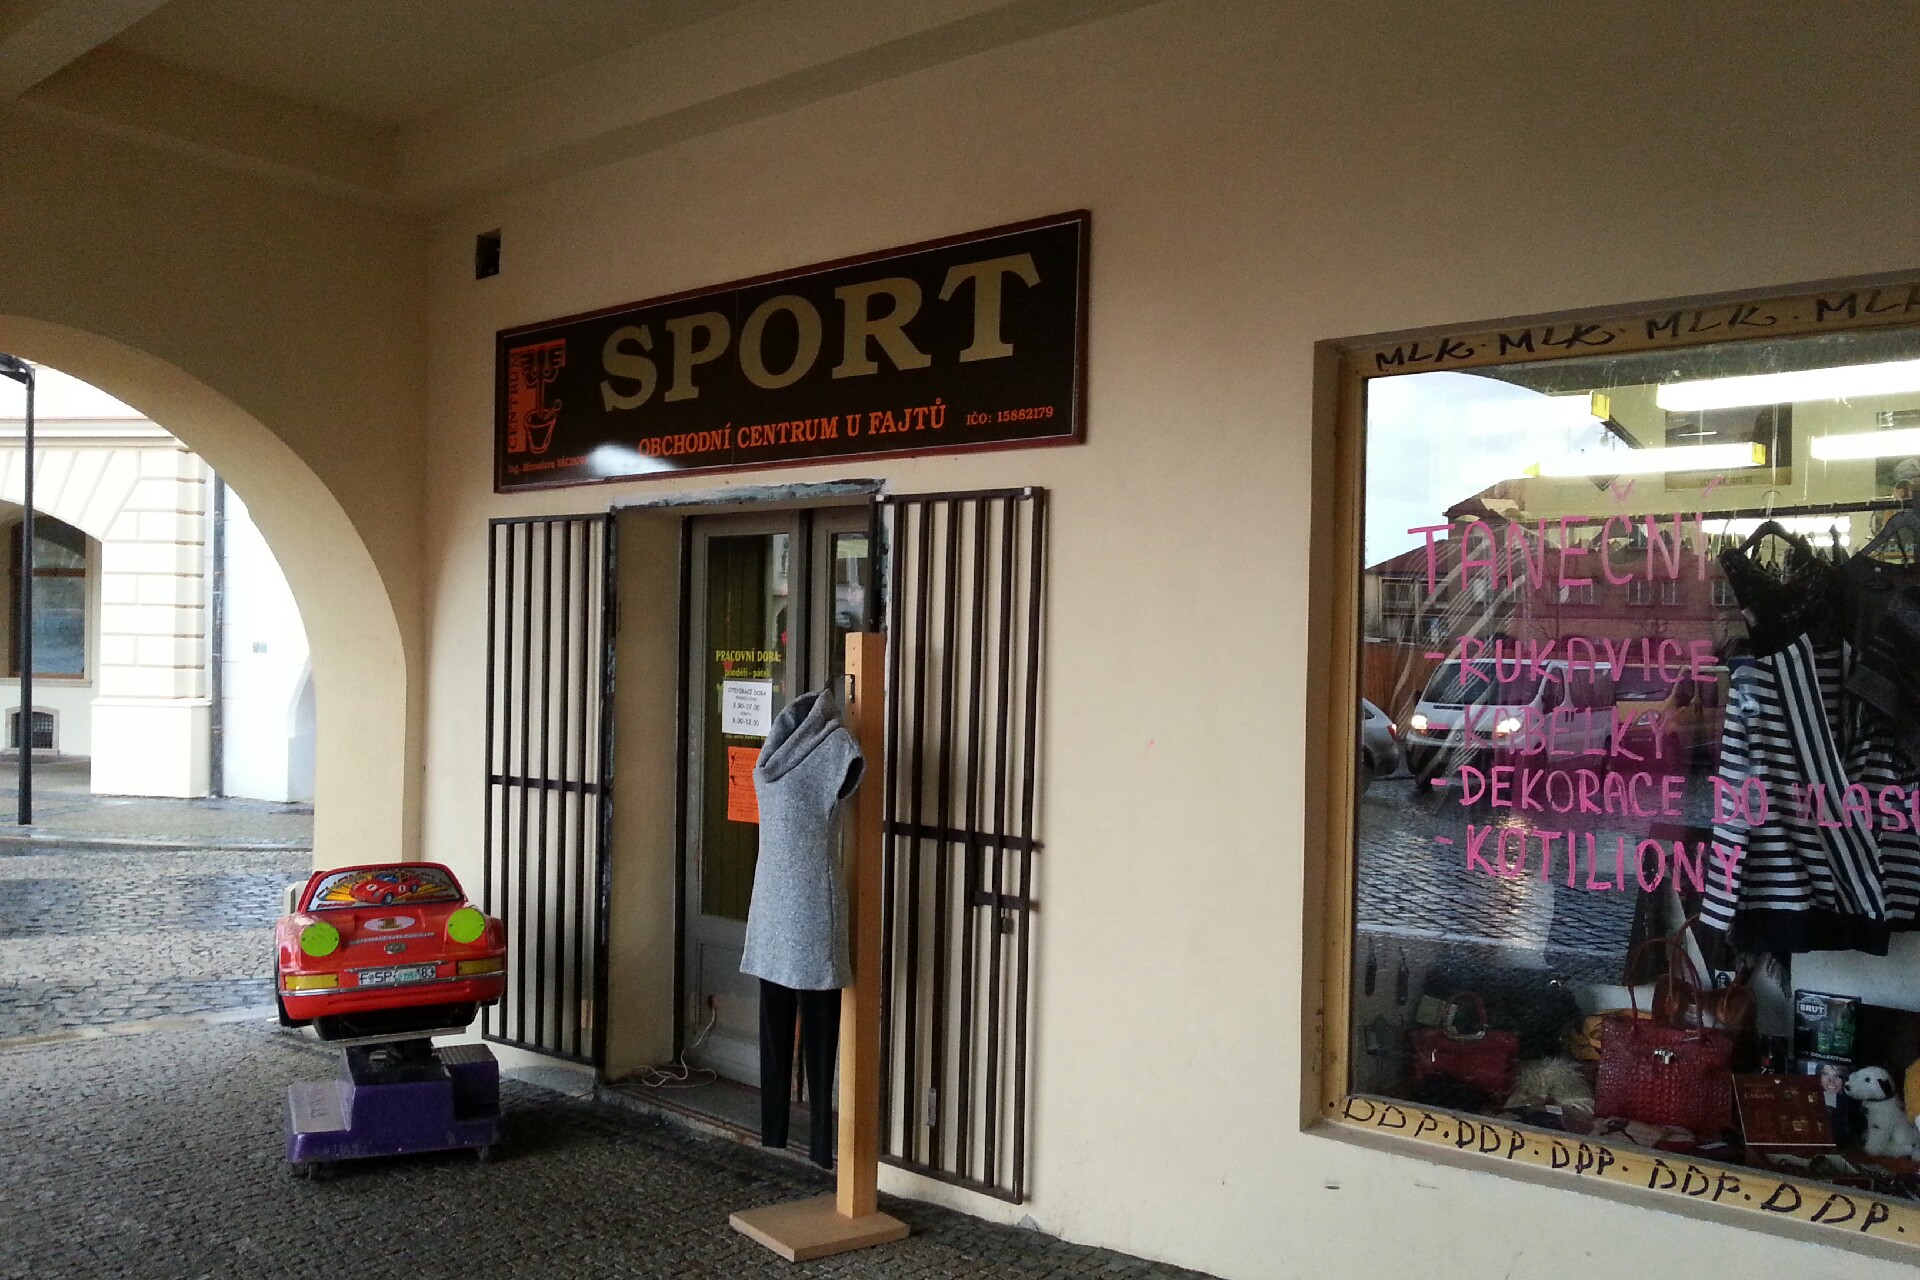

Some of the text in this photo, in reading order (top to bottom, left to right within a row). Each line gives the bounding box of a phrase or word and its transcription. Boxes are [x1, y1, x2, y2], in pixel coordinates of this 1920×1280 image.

[600, 252, 1041, 412] SPORT
[639, 397, 1054, 457] OBCHODNÍ CENTRUM U FAJTŮ IČO: 15882179
[1407, 476, 1723, 596] TANEČNÍ
[715, 648, 782, 662] PRACOVNÍ DOBA:
[1708, 775, 1769, 827] DO
[1800, 1003, 1825, 1013] BRUT
[1810, 1051, 1852, 1063] COLLECTION
